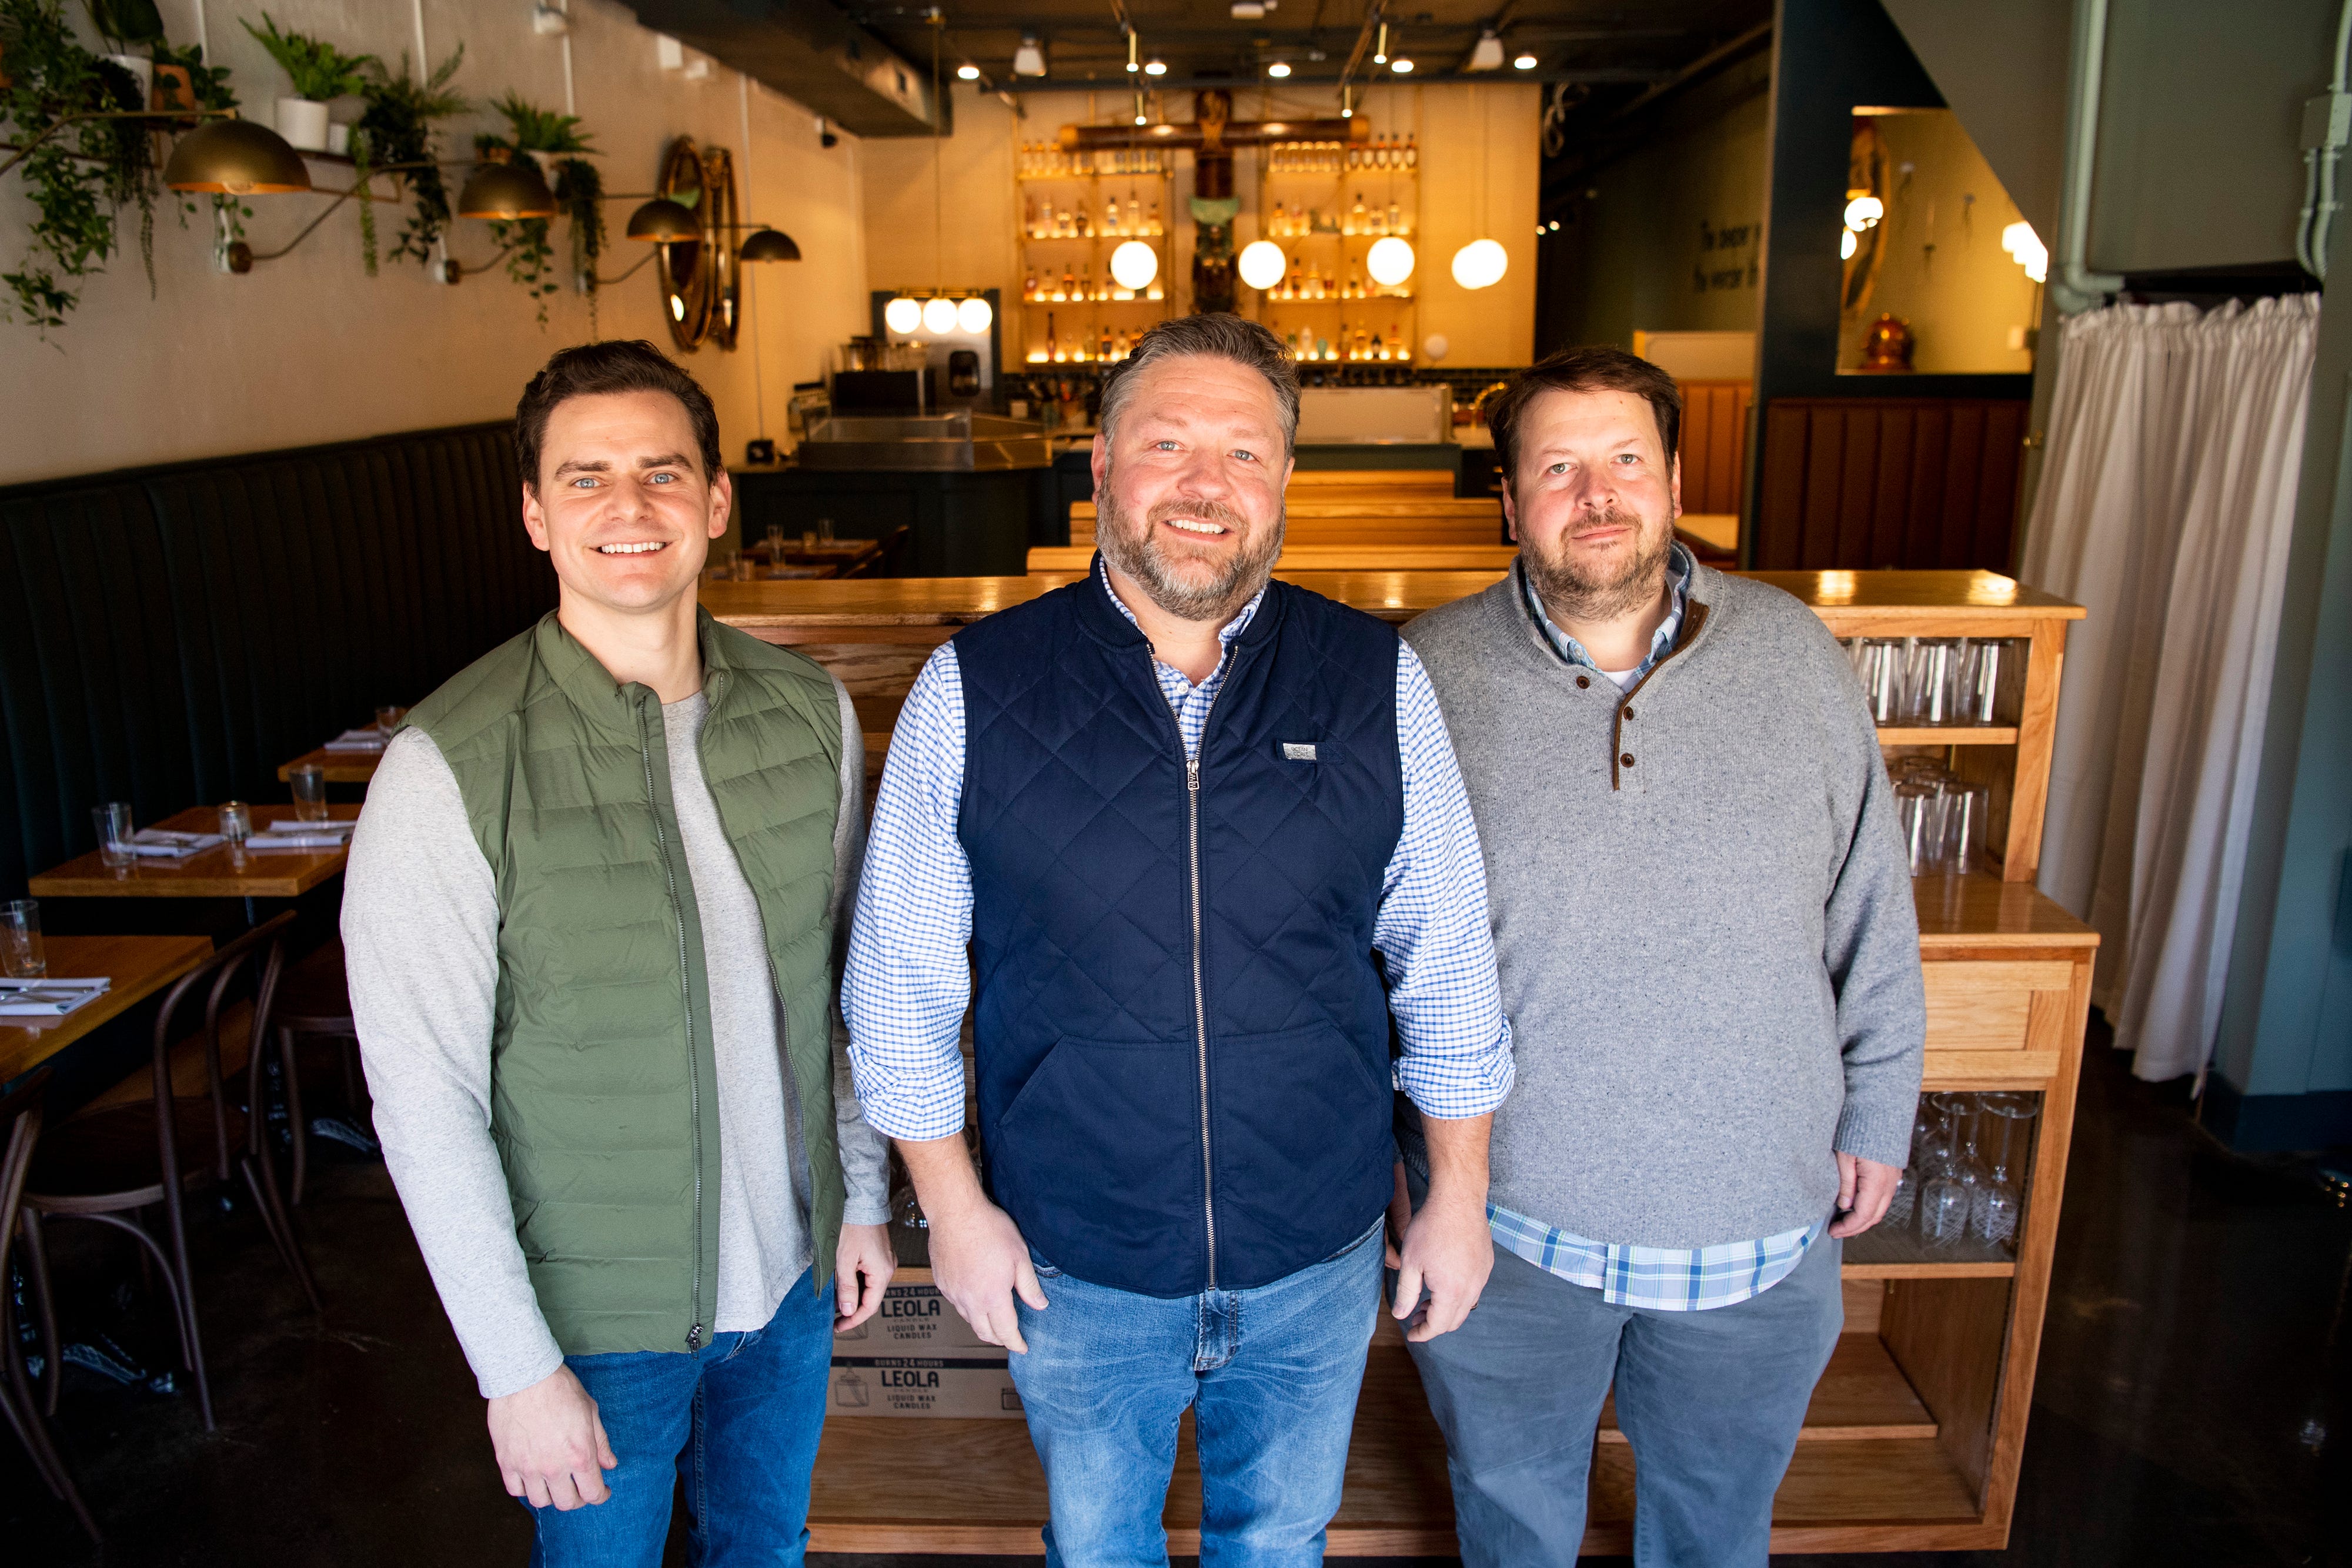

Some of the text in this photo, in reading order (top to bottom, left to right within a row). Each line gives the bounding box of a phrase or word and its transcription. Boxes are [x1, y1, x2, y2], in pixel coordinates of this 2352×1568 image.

[903, 1288, 916, 1297] 24
[881, 1299, 940, 1318] LEOLA
[881, 1370, 940, 1388] LEOLA
